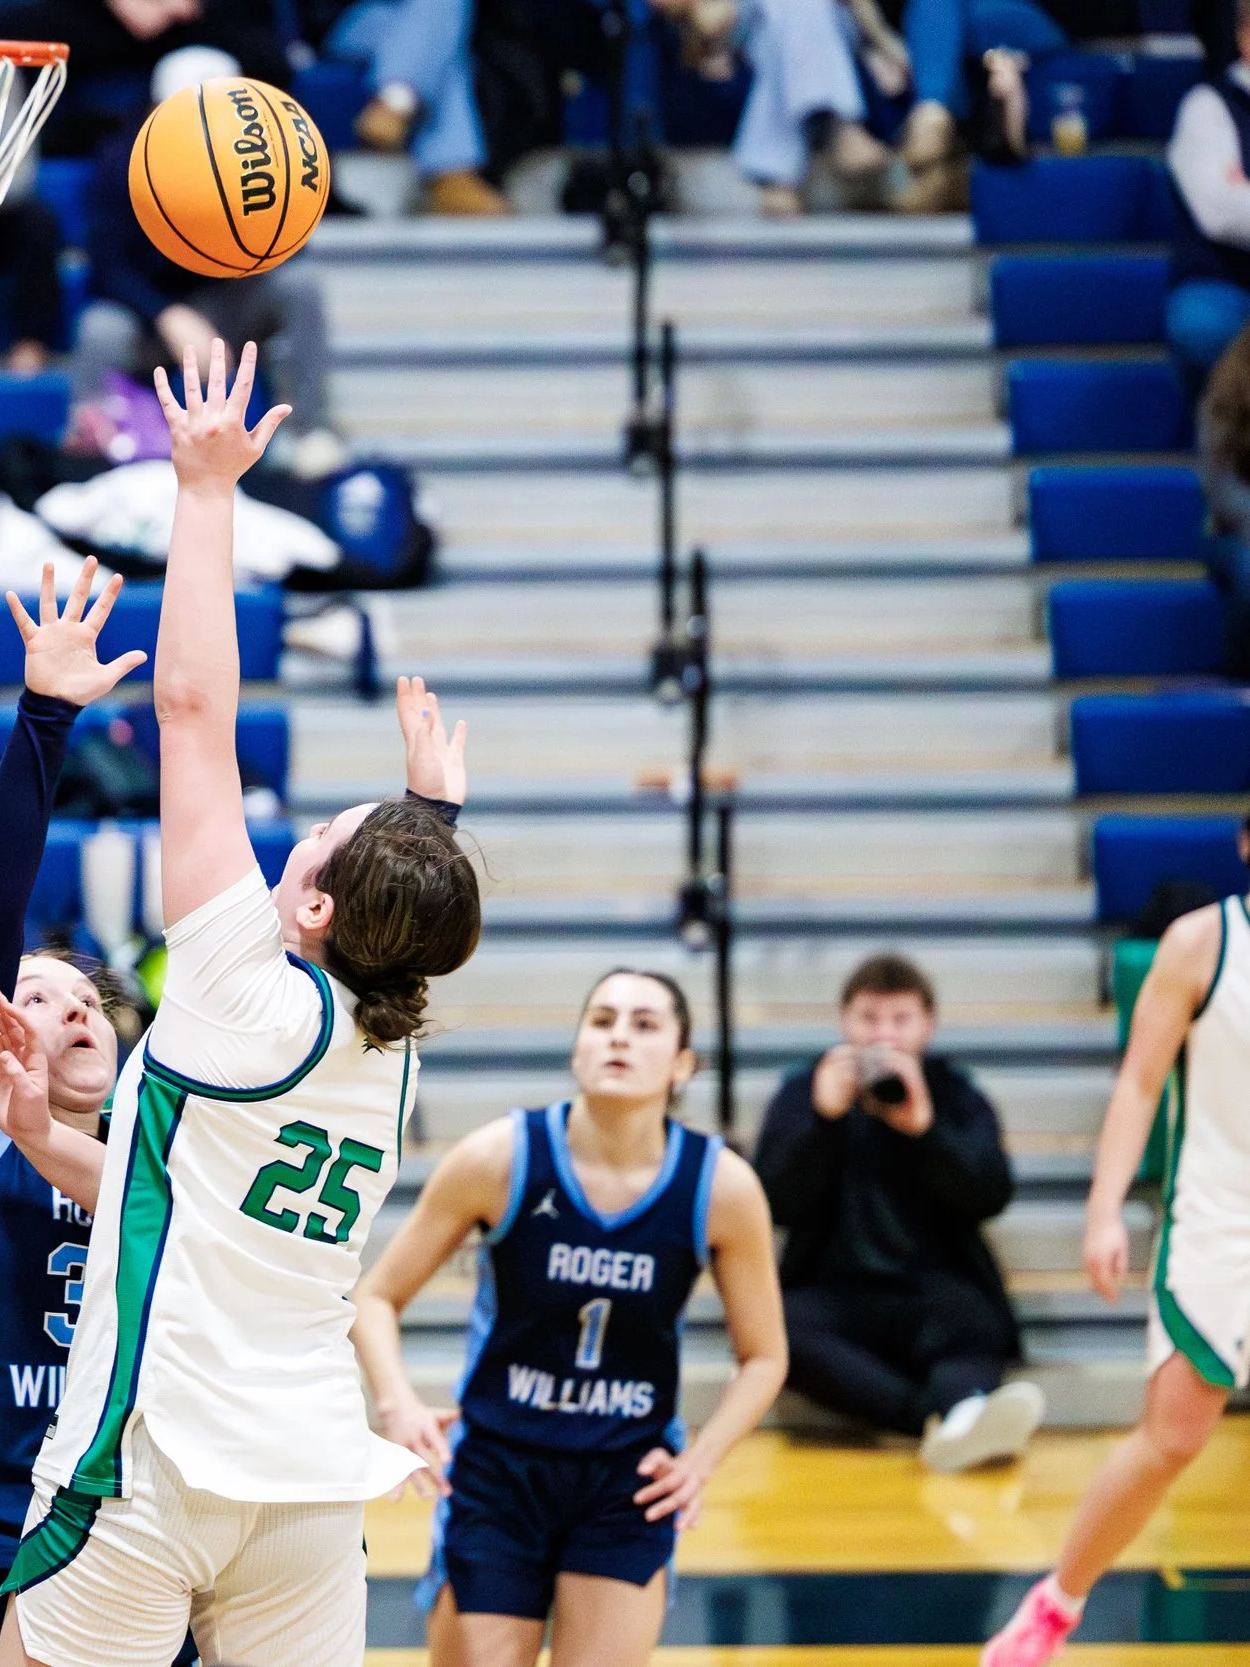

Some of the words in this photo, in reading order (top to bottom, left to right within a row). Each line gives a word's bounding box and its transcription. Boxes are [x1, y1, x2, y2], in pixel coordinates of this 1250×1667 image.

[227, 87, 277, 217] Wilson
[279, 100, 319, 193] NCAA
[238, 1120, 385, 1245] 25
[547, 1243, 656, 1292] ROGER
[575, 1298, 613, 1369] 1
[508, 1363, 656, 1418] WILLIAMS
